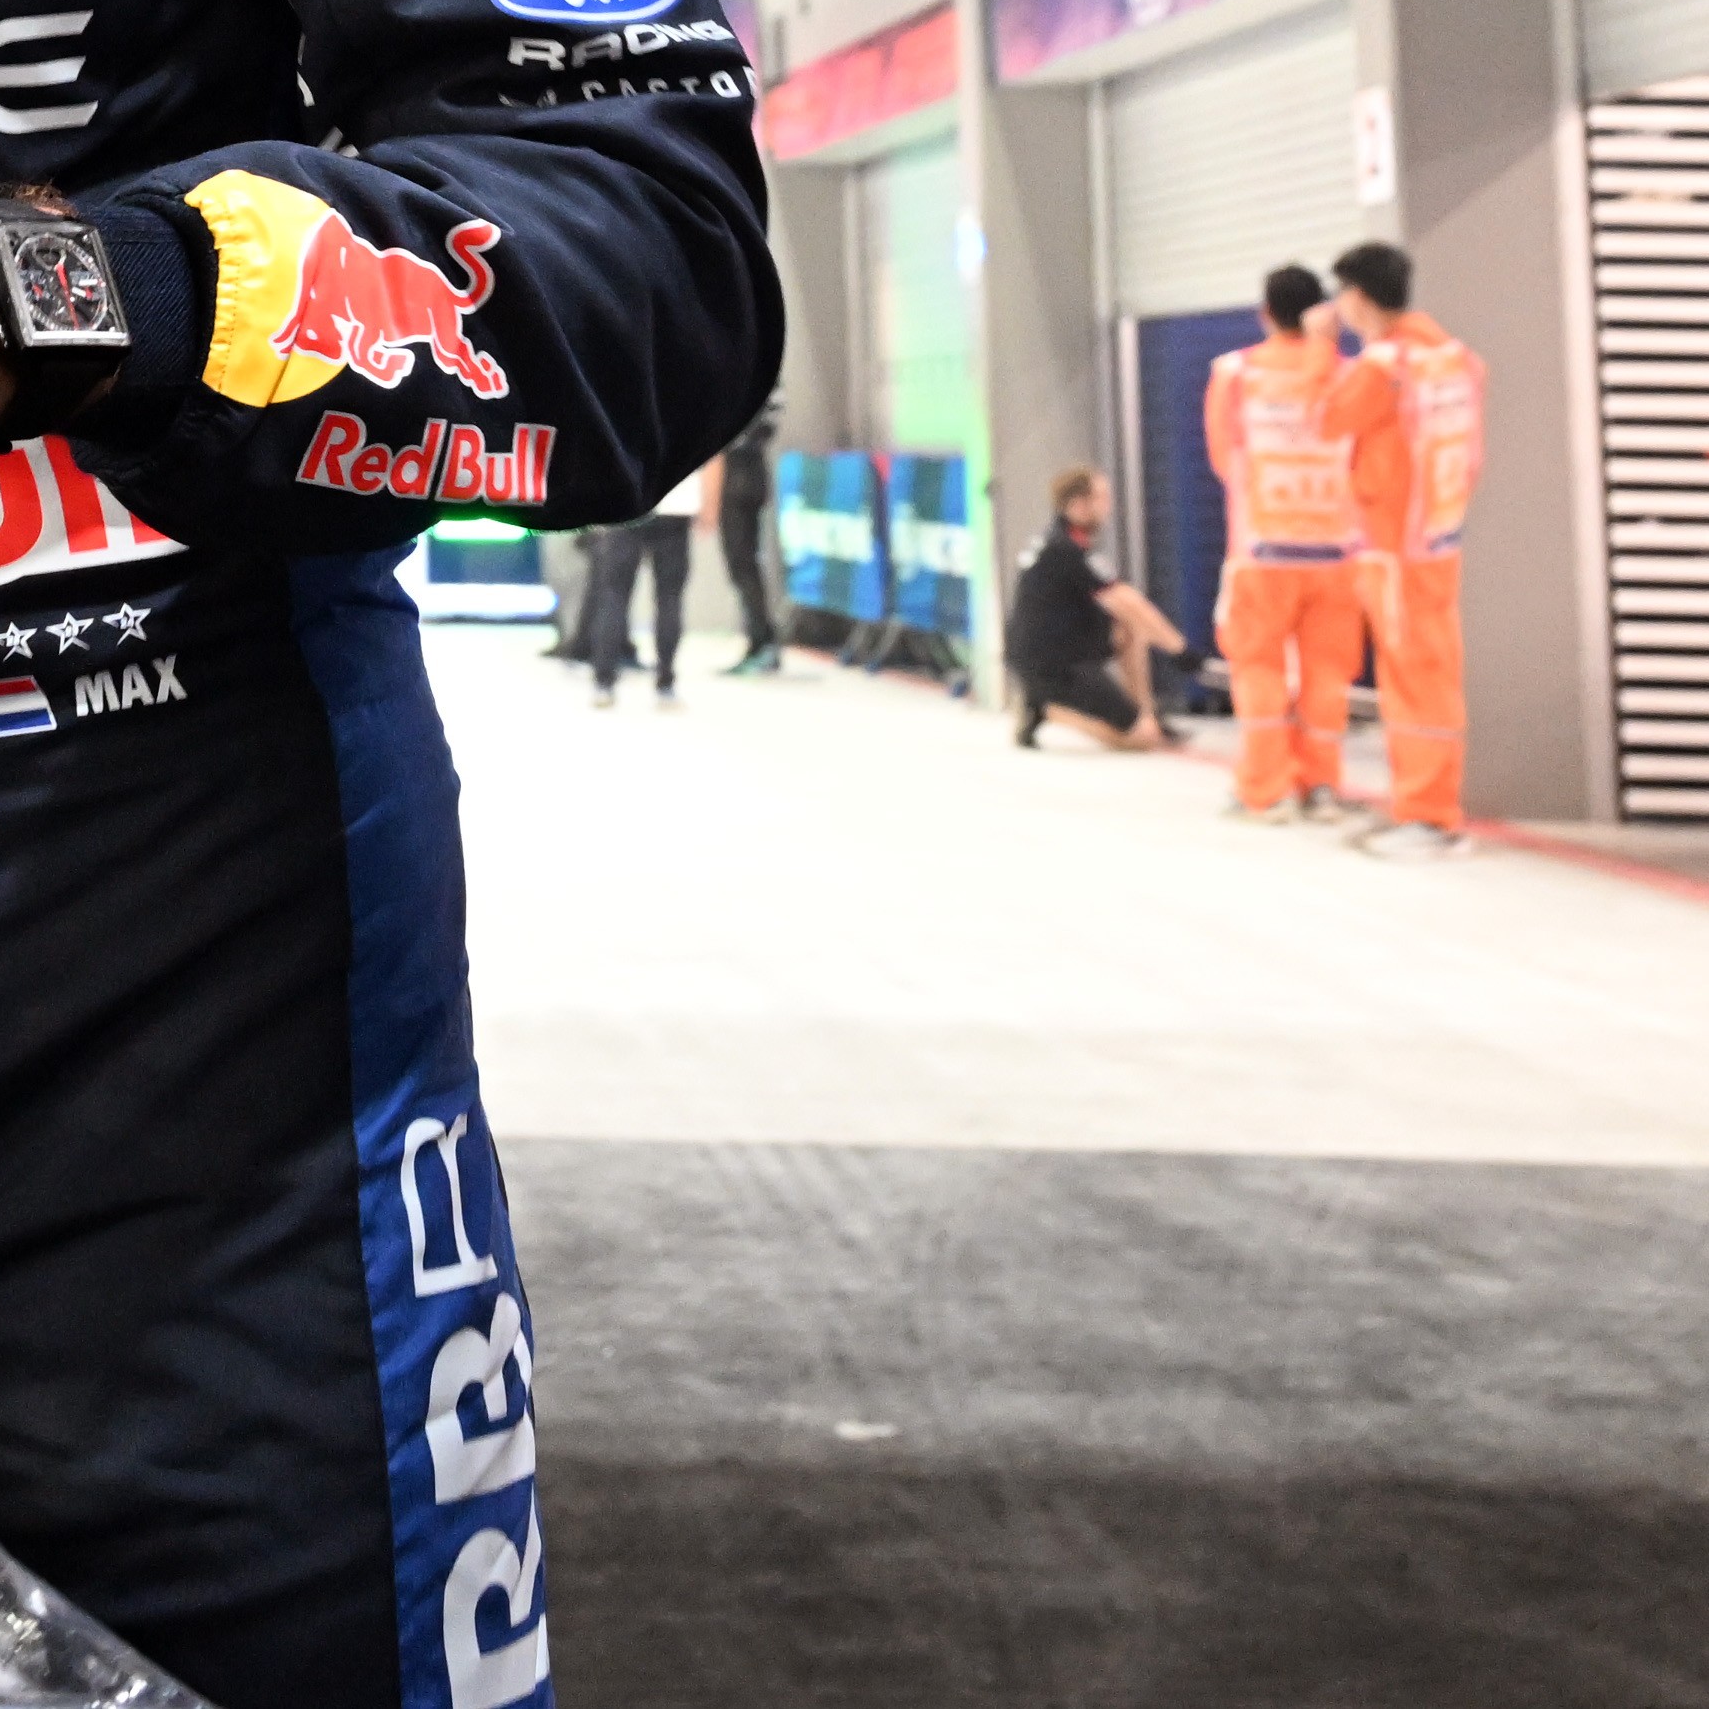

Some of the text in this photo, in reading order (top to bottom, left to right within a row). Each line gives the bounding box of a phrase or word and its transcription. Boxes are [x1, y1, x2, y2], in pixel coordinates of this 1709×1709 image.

[295, 410, 557, 506] Red Bull
[74, 652, 189, 718] MAX
